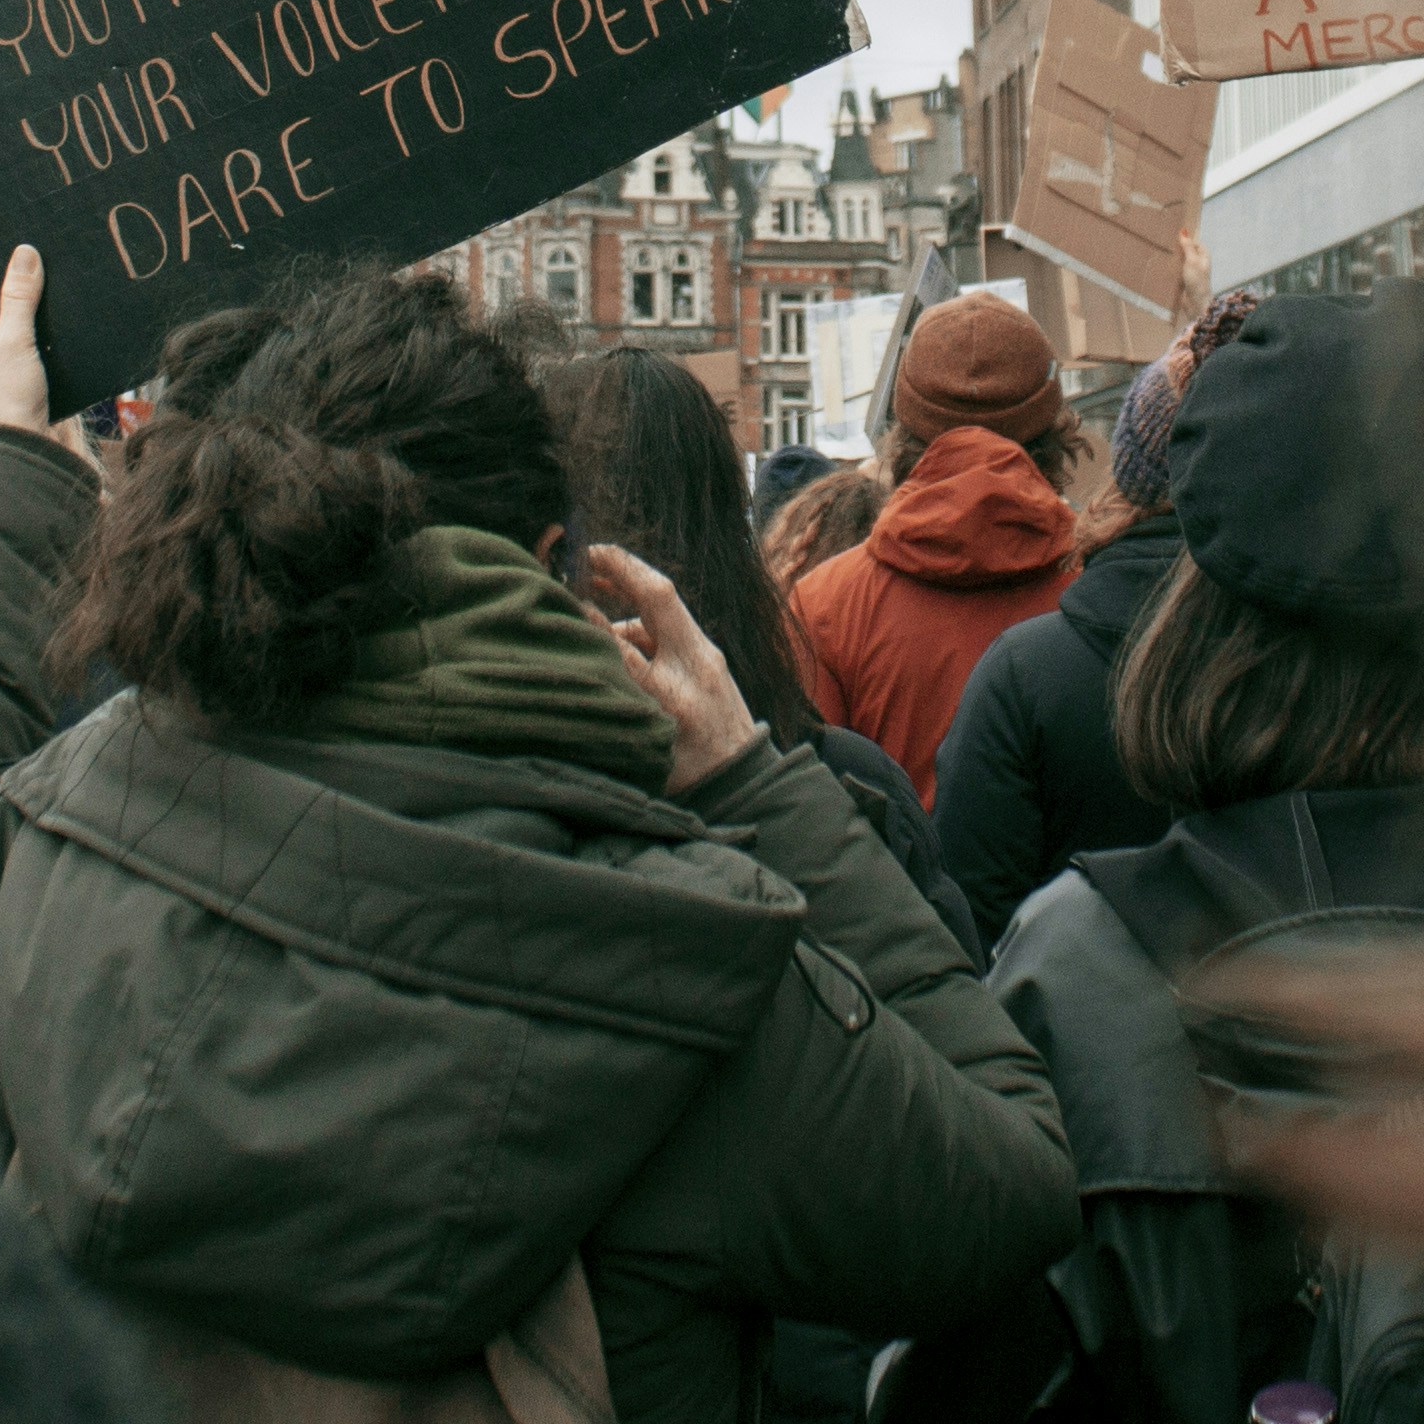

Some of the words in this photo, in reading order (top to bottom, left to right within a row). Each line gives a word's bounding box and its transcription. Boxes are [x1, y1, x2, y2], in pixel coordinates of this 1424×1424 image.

[21, 57, 196, 186] YOUR
[108, 116, 335, 281] DARE
[359, 58, 466, 158] TO
